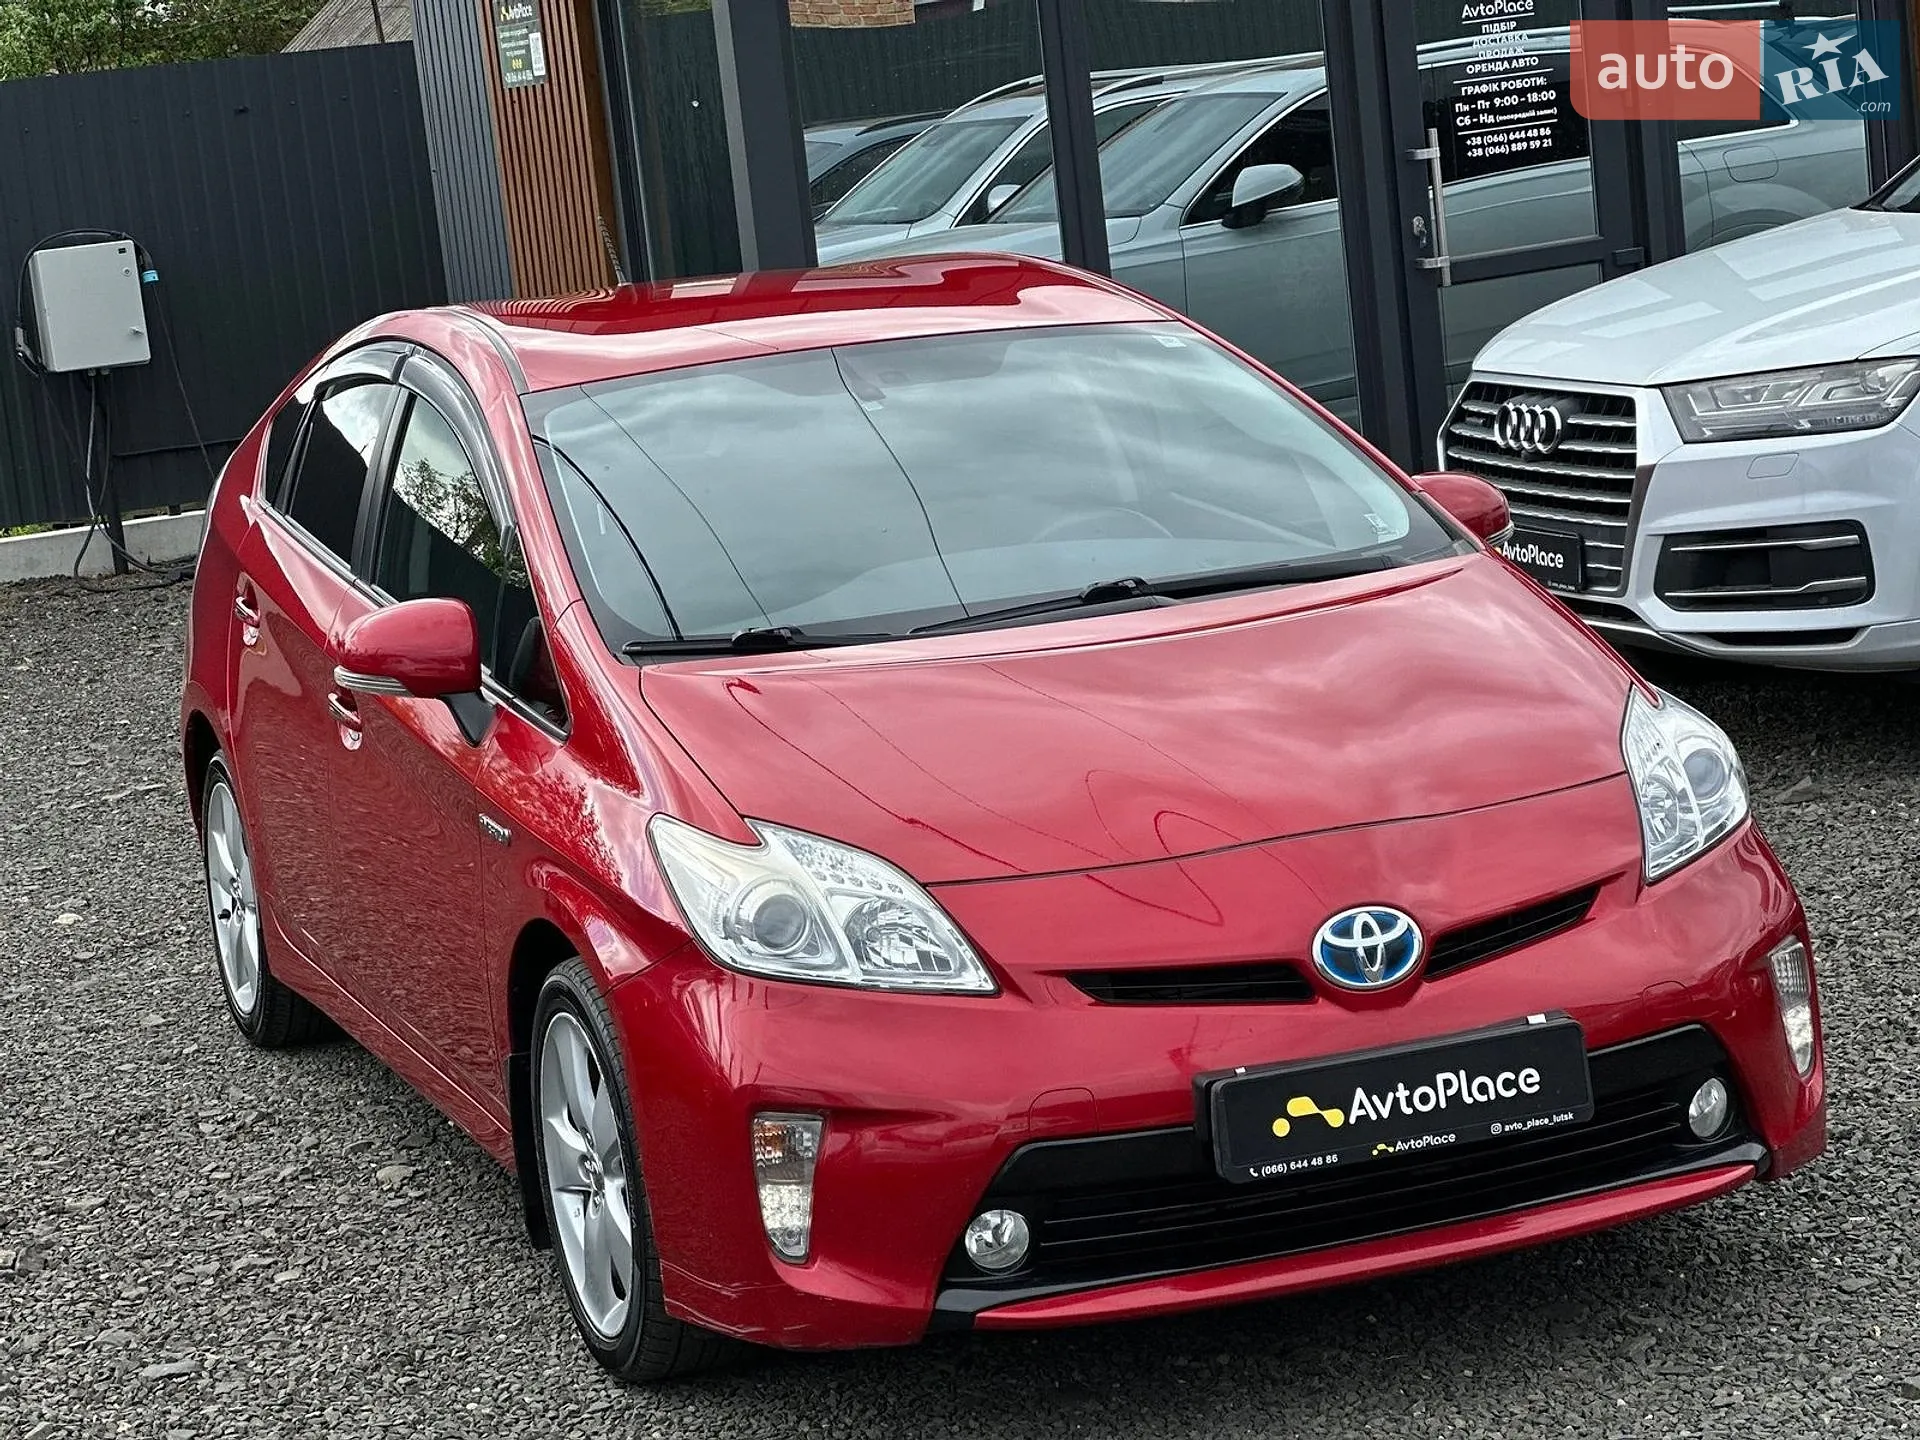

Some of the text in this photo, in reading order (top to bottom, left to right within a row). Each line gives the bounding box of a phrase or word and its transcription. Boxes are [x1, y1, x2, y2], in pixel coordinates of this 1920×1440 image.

[1461, 0, 1534, 18] AvtoPlace
[1481, 21, 1517, 34] ПІДБІР
[1472, 33, 1529, 48] ДОСТАВКА
[1478, 46, 1525, 60] ПРОДАЖ
[1466, 56, 1539, 74] ОРЕНДА АВТО
[1461, 76, 1548, 96] ГРАФІК РОБОТИ:
[1455, 103, 1470, 113] Пн
[1477, 100, 1491, 110] Пт
[1456, 115, 1472, 127] Сб
[1479, 113, 1495, 125] Нд
[1466, 137, 1482, 146] +38
[1509, 130, 1527, 141] 644
[1467, 148, 1483, 158] +38
[1529, 139, 1541, 149] 59
[1542, 137, 1553, 148] 21
[1502, 541, 1564, 568] AvtoPlace
[1348, 1067, 1541, 1125] AvtoPlace
[1395, 1132, 1456, 1152] AvtoPlace
[1261, 1153, 1339, 1177] (066) 644 48 86
